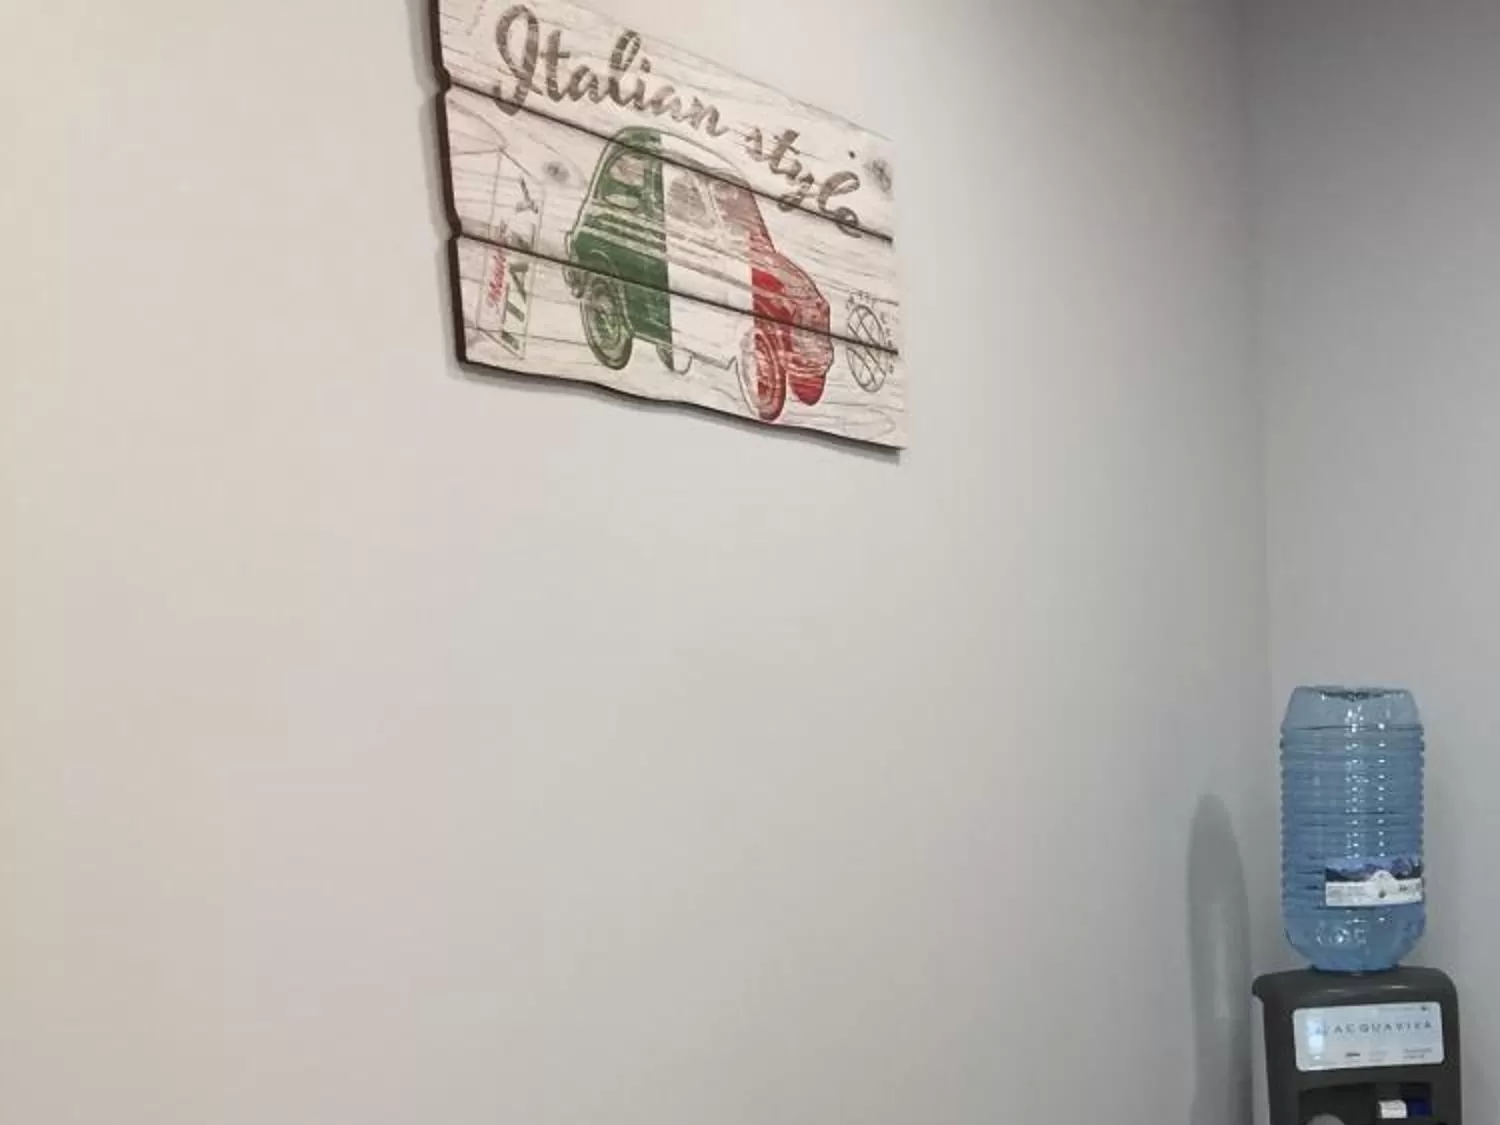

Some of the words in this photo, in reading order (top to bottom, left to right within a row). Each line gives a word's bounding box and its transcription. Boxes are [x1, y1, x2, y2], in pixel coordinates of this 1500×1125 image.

[492, 4, 730, 137] Italian
[744, 125, 863, 238] style
[1333, 1019, 1433, 1034] ACQUAVIVA
